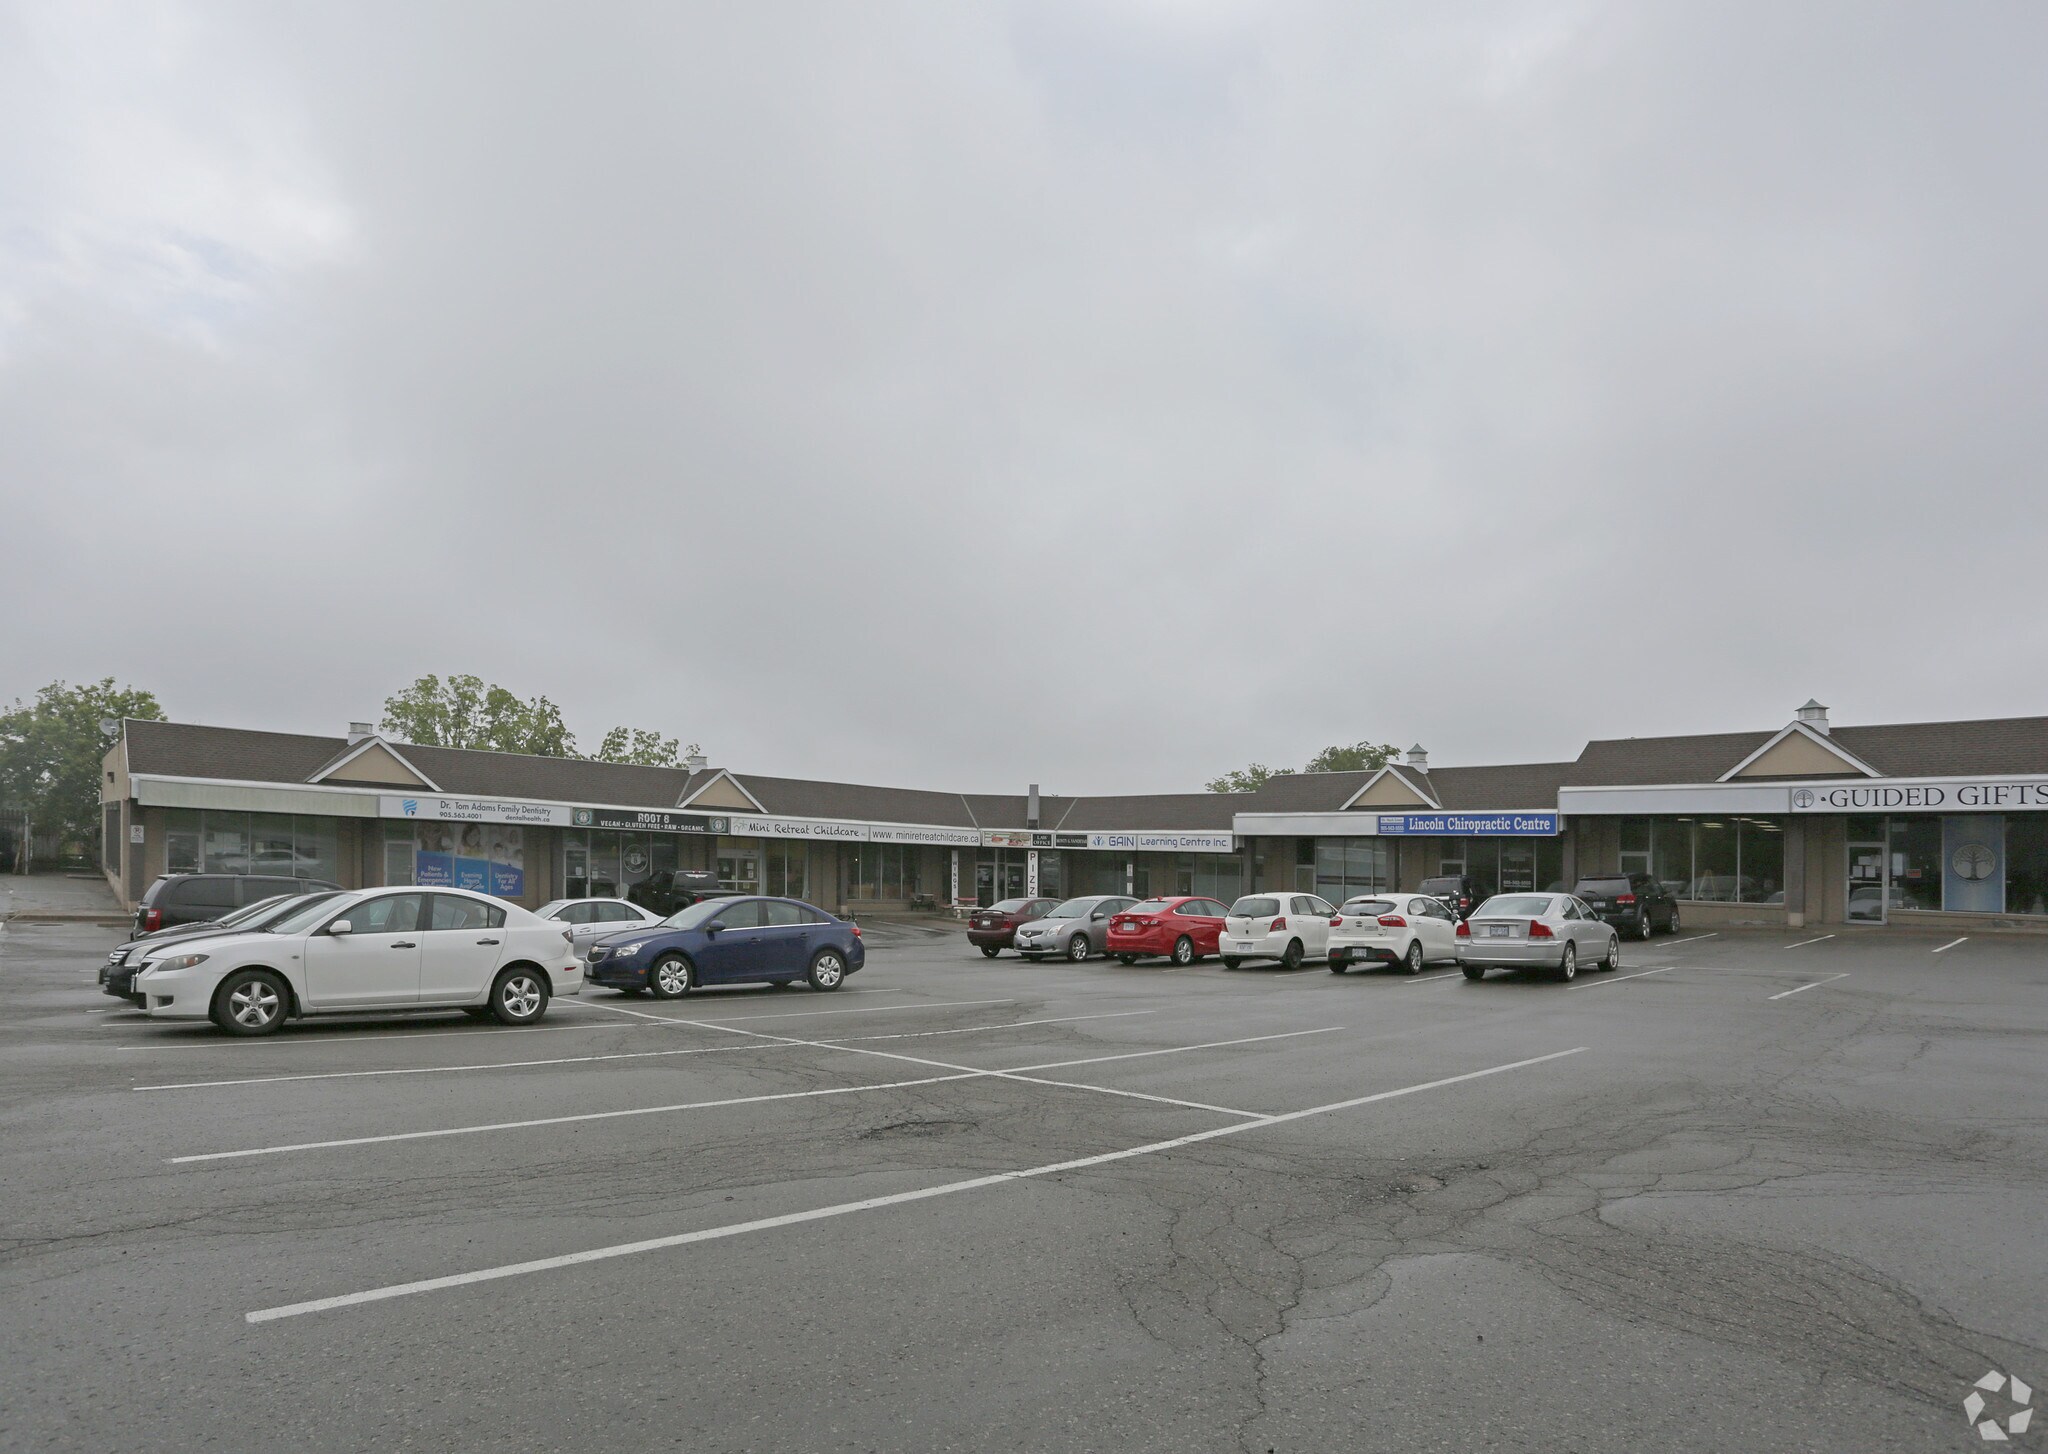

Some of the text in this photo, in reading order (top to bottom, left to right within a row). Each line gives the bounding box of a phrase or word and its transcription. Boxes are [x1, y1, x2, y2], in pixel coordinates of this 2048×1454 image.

[1829, 784, 2048, 807] GUIDED GIFTS
[440, 801, 551, 817] Dr. Tom Adams Family Dentistry
[637, 813, 670, 823] ROOT 8
[1409, 818, 1445, 830] Lincoln
[1447, 817, 1511, 833] Chiropractic
[1514, 817, 1550, 831] Centre
[748, 823, 770, 832] Mini
[774, 823, 810, 834] Retreat
[813, 825, 859, 837] Childcare
[1108, 836, 1229, 848] GAIN Learning Centre Inc.
